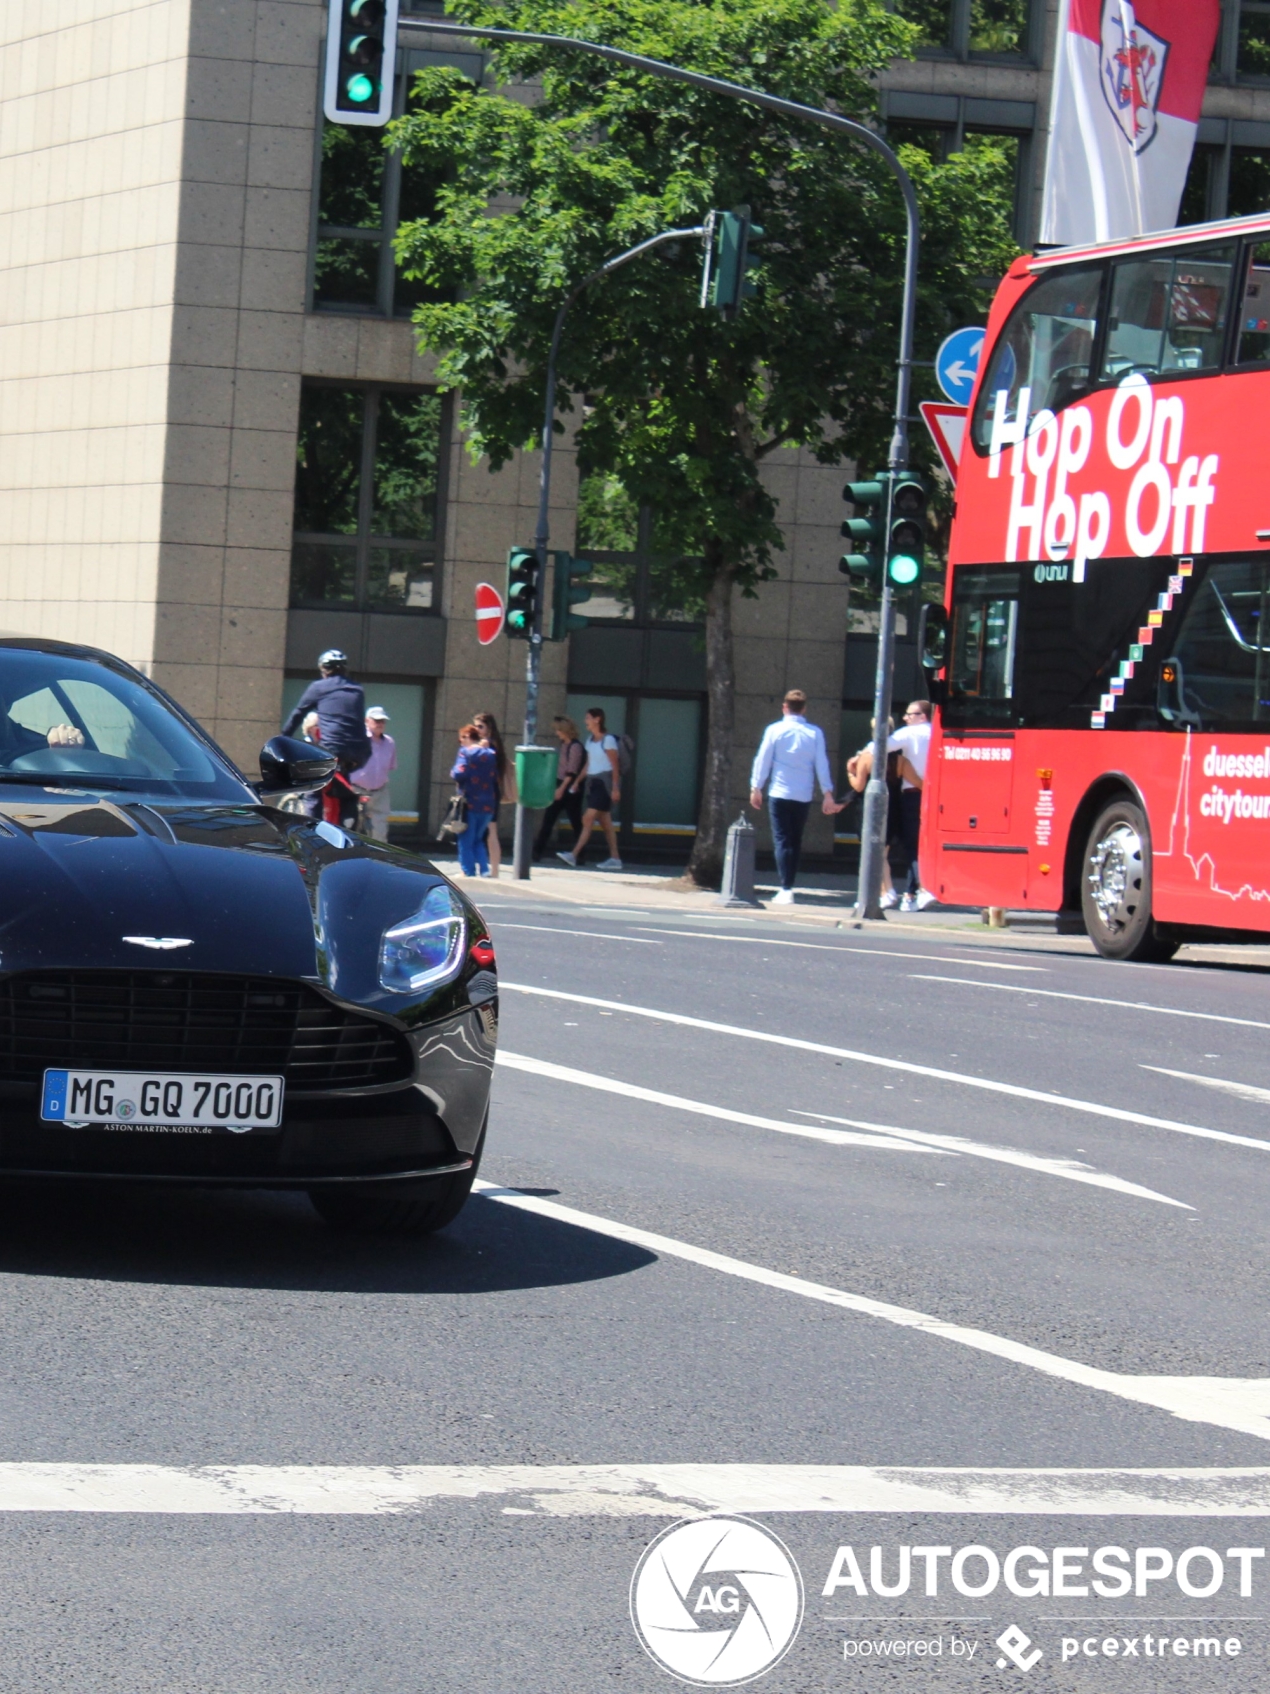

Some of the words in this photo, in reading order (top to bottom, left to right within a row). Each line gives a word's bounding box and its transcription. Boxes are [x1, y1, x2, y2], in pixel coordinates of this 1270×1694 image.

[988, 387, 1093, 497] Hop
[1106, 372, 1185, 470] On
[1005, 472, 1110, 583] Hop
[1125, 454, 1219, 558] Off
[1203, 745, 1270, 778] duessel
[50, 1099, 60, 1112] D
[70, 1077, 115, 1116] MG
[140, 1080, 183, 1118] GQ
[192, 1082, 274, 1120] 7000
[103, 1123, 133, 1132] ASTON
[135, 1125, 212, 1134] MARTIN-KOELN.de
